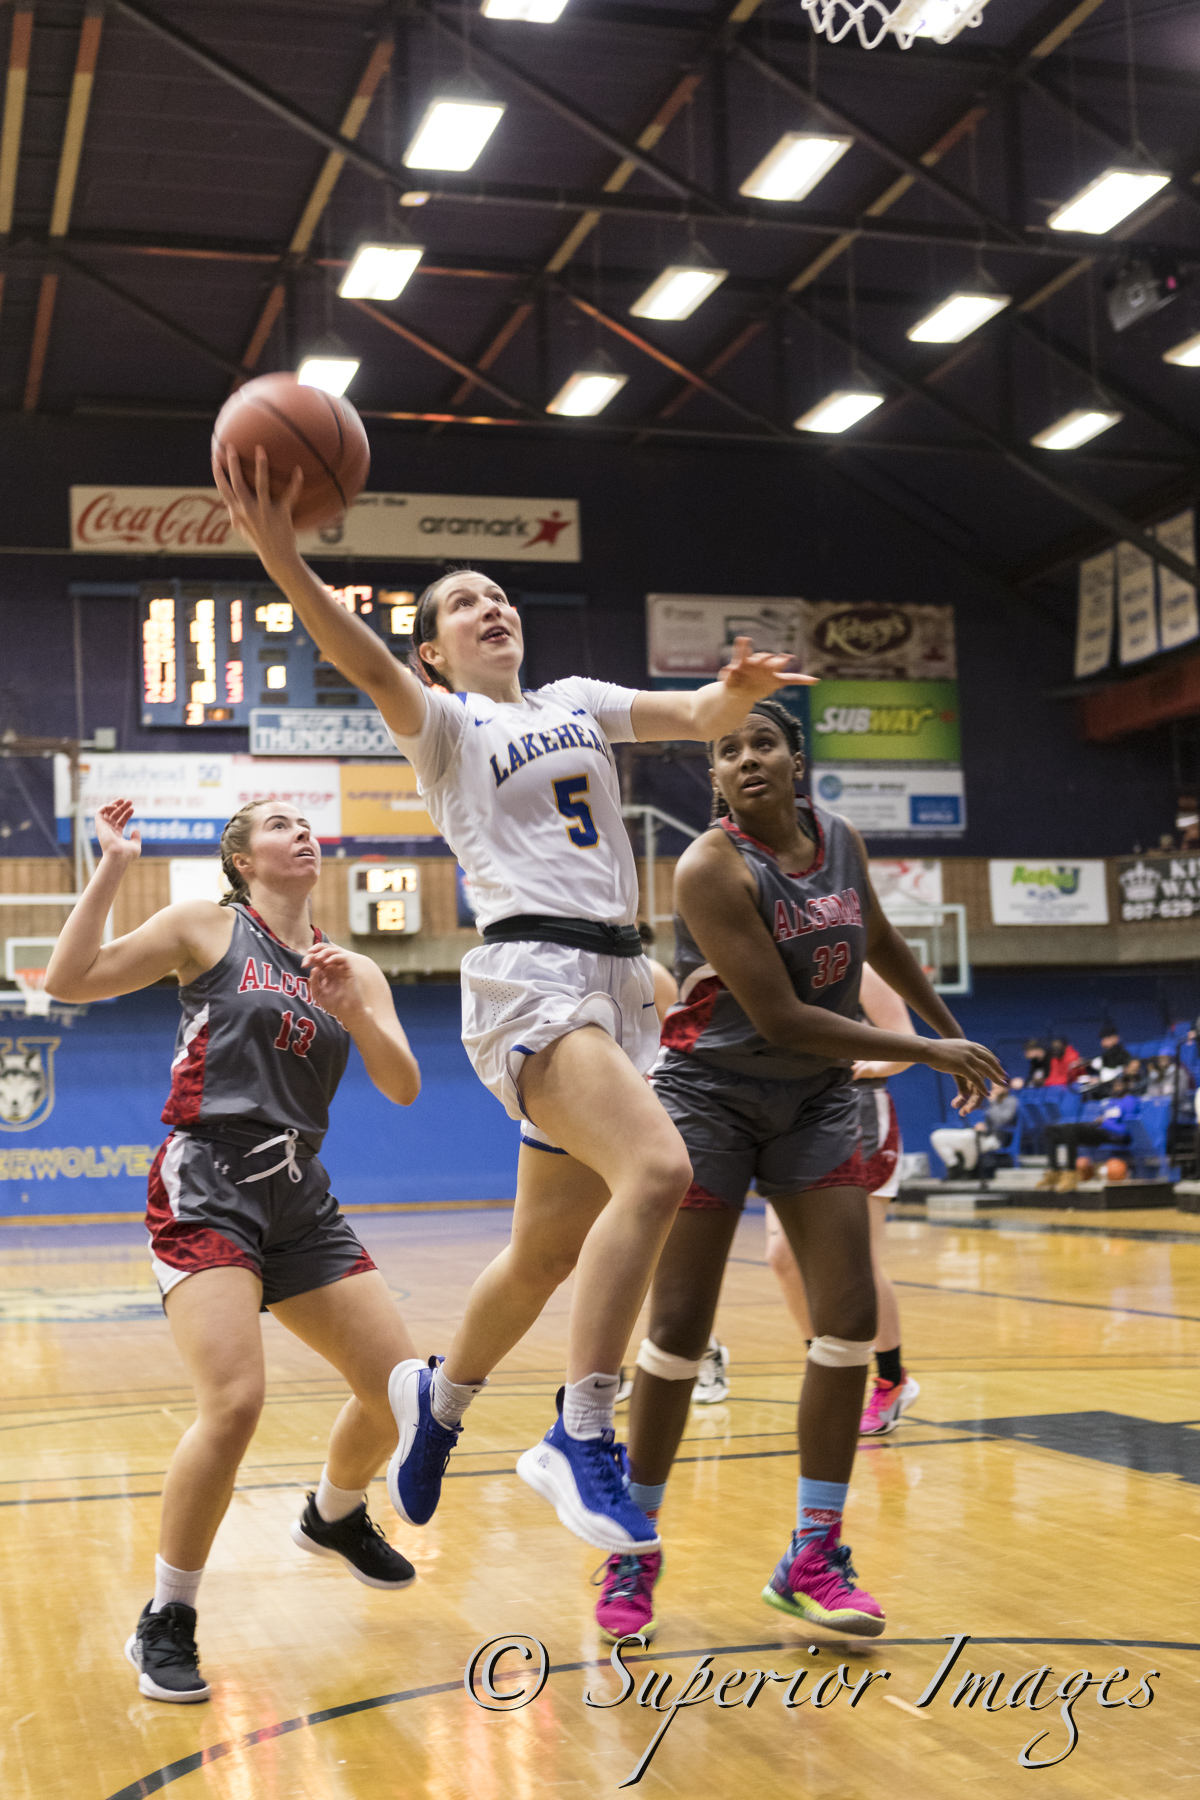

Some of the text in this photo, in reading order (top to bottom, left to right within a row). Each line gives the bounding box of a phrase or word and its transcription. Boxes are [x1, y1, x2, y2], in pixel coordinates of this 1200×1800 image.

[77, 492, 232, 546] Coca-Cola
[418, 515, 529, 537] aramark
[815, 706, 934, 734] SUBWAY
[551, 773, 600, 850] 5
[810, 941, 851, 989] 32
[274, 1010, 317, 1058] 13
